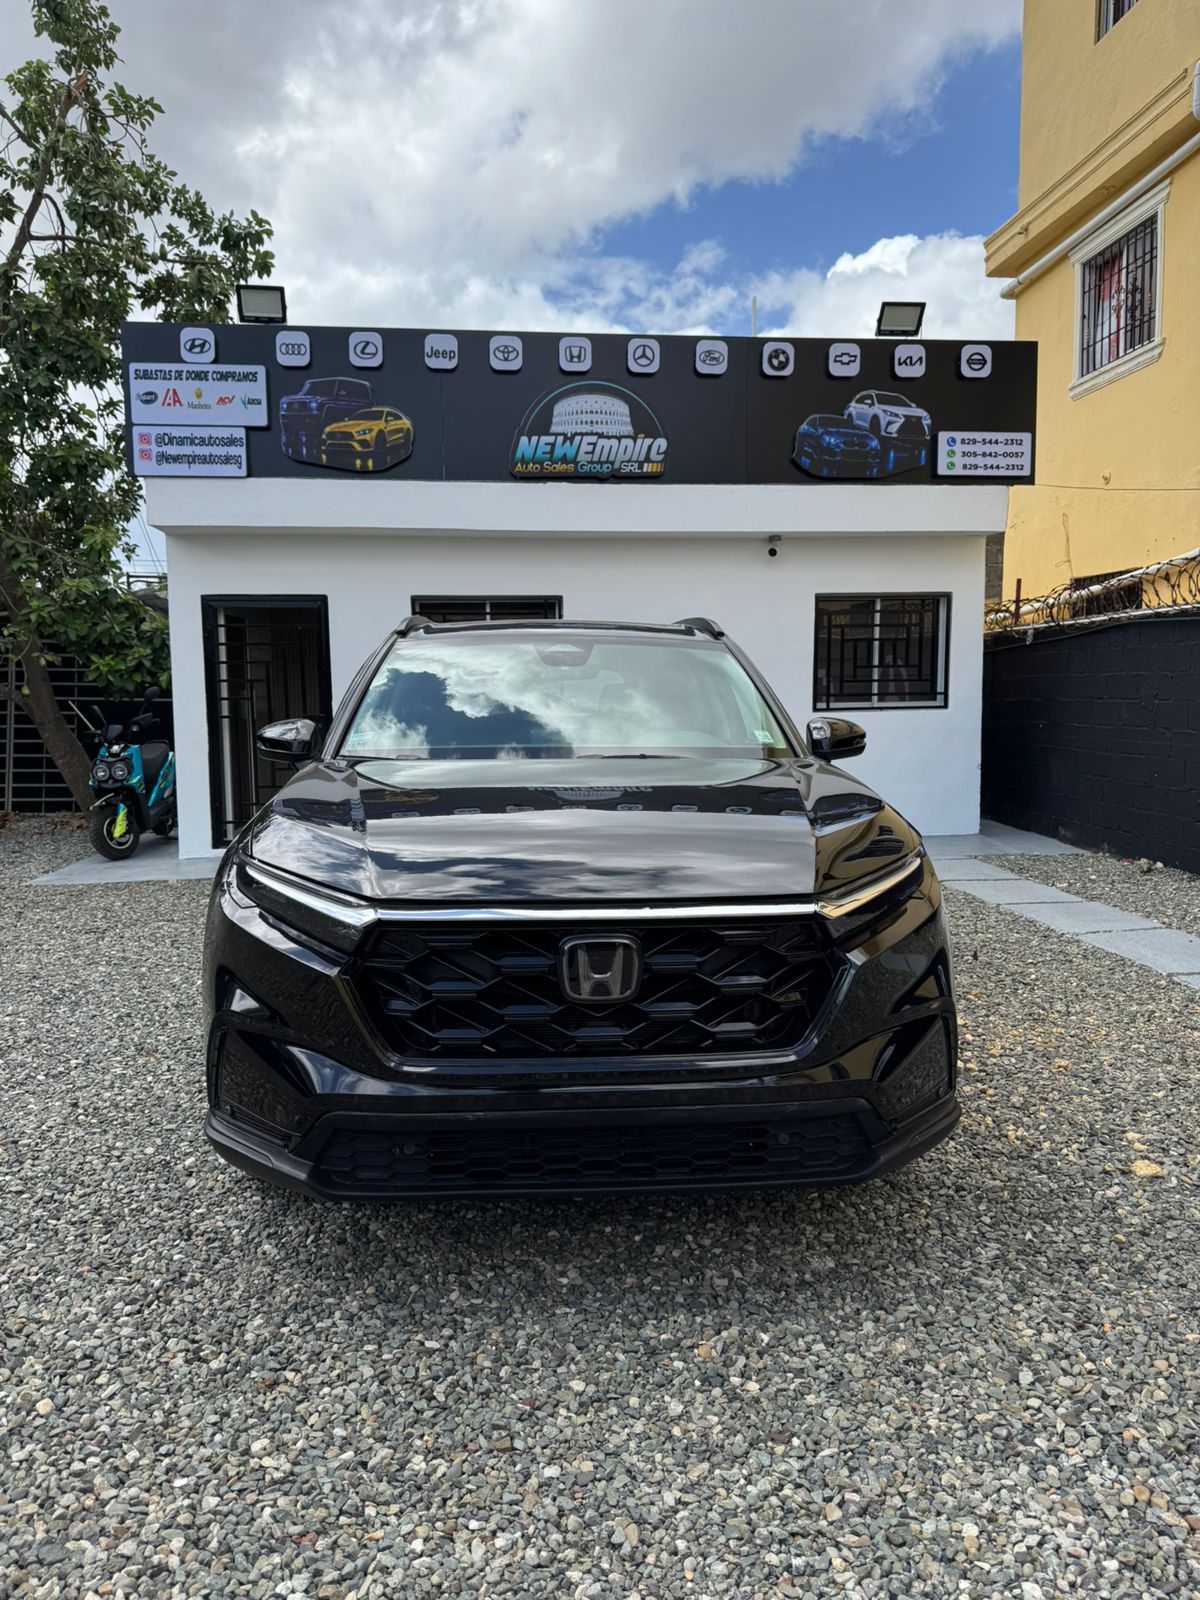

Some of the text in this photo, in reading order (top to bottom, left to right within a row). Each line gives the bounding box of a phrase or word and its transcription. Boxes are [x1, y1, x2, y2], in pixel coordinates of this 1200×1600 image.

[426, 346, 456, 361] Jeep
[134, 369, 258, 382] SUBASTAS DE DONDE COMPRAMOS
[155, 433, 244, 447] @Dinamicautosales
[960, 438, 1024, 446] 829-544-2312
[156, 451, 242, 469] @Newempireautosalesg
[961, 451, 1025, 459] 305-842-0057
[514, 462, 642, 474] Auto Sales Group SRL
[962, 463, 1025, 471] 829-544-2312
